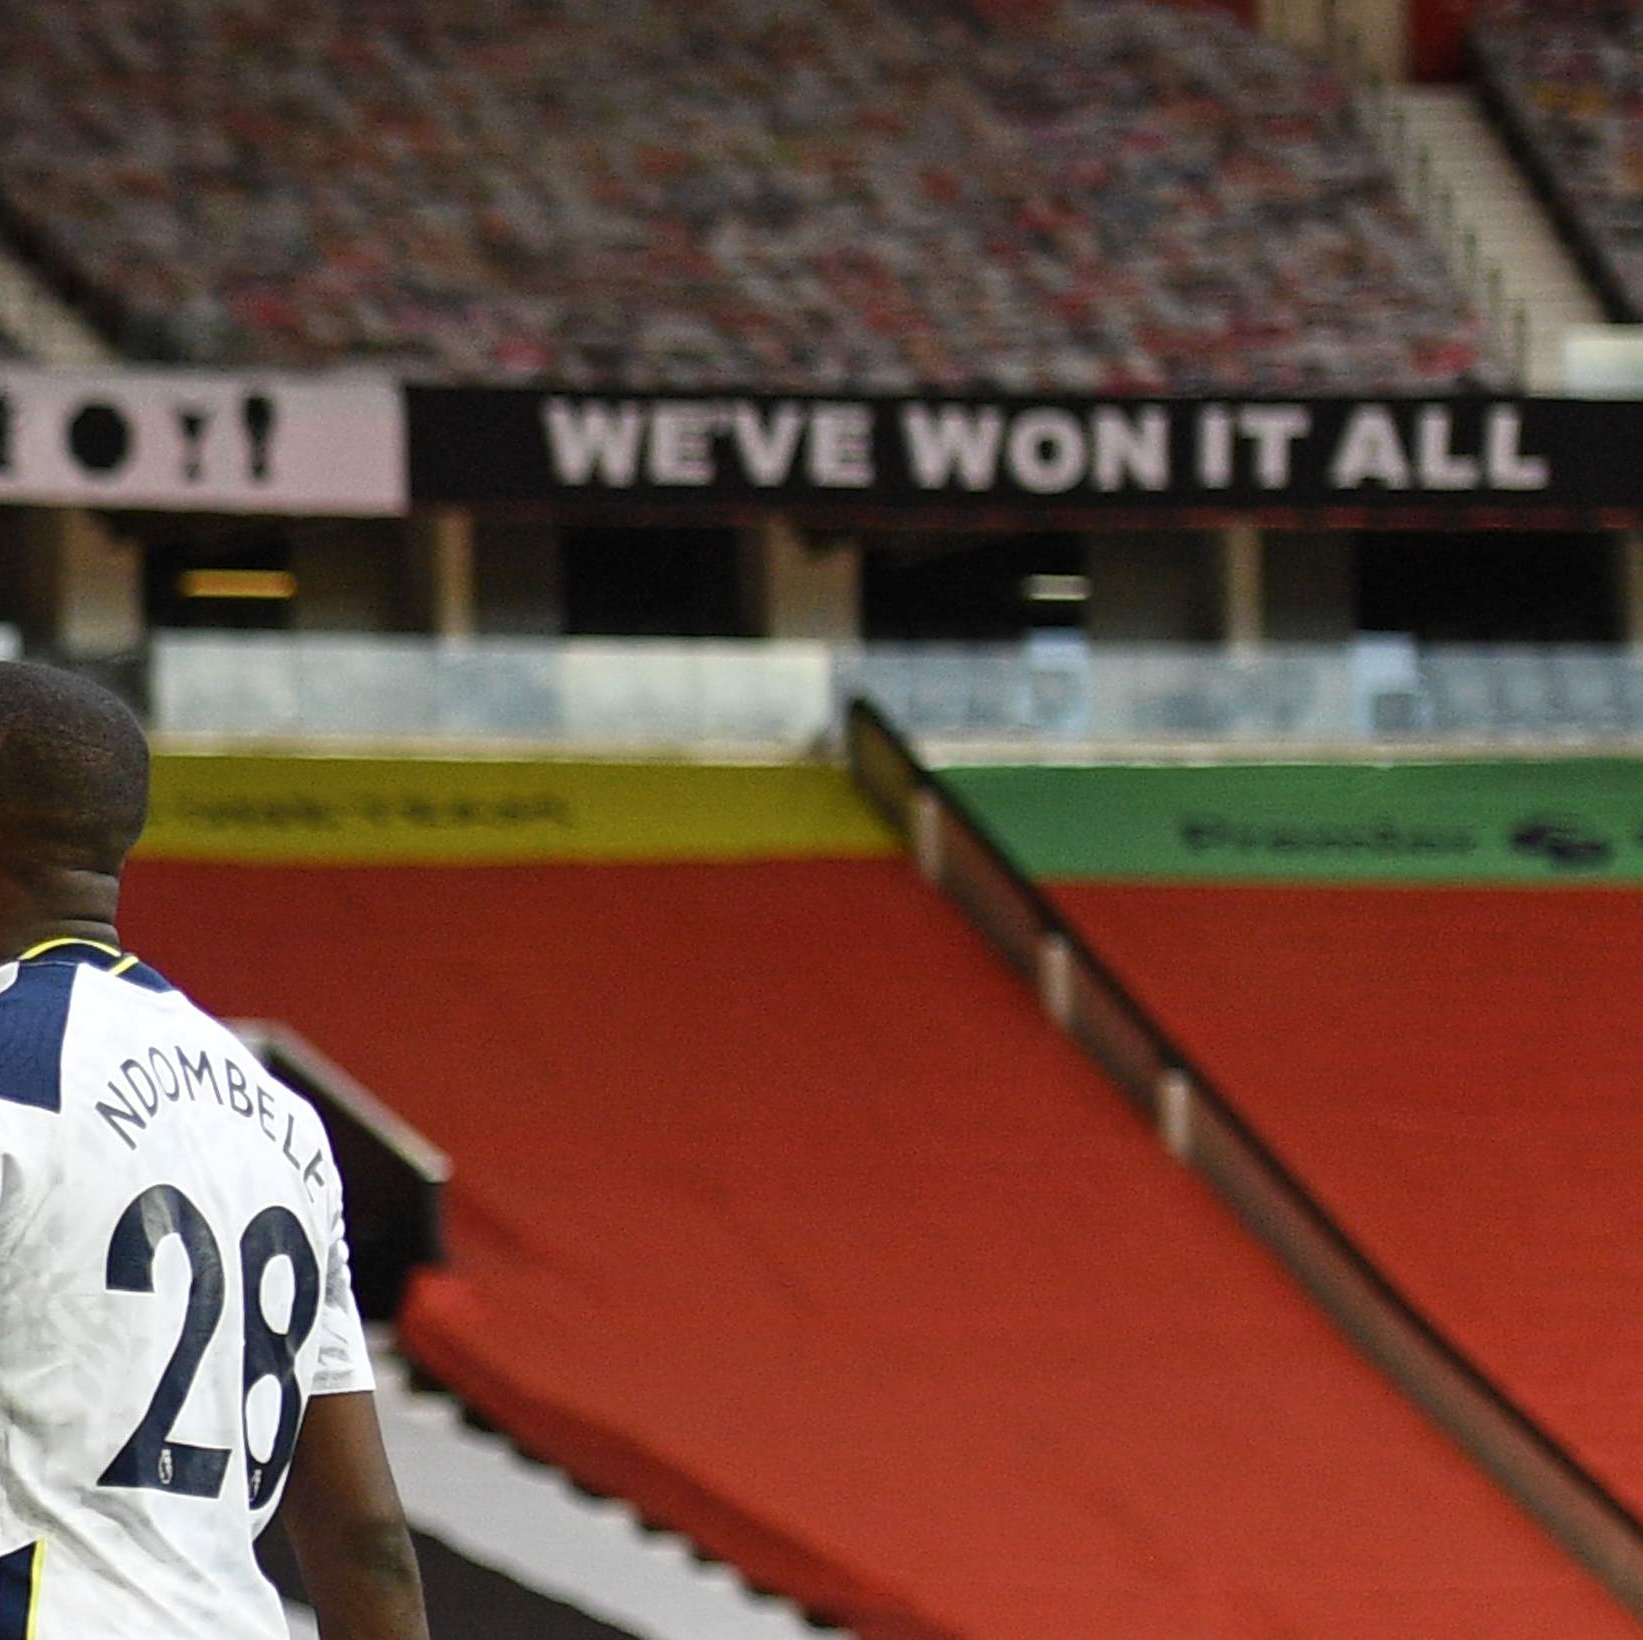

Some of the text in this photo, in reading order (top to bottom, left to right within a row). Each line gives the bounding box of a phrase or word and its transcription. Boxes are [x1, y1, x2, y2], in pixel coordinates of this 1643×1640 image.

[542, 400, 1549, 494] WE'VE WON IT ALL
[96, 1184, 320, 1511] 28
